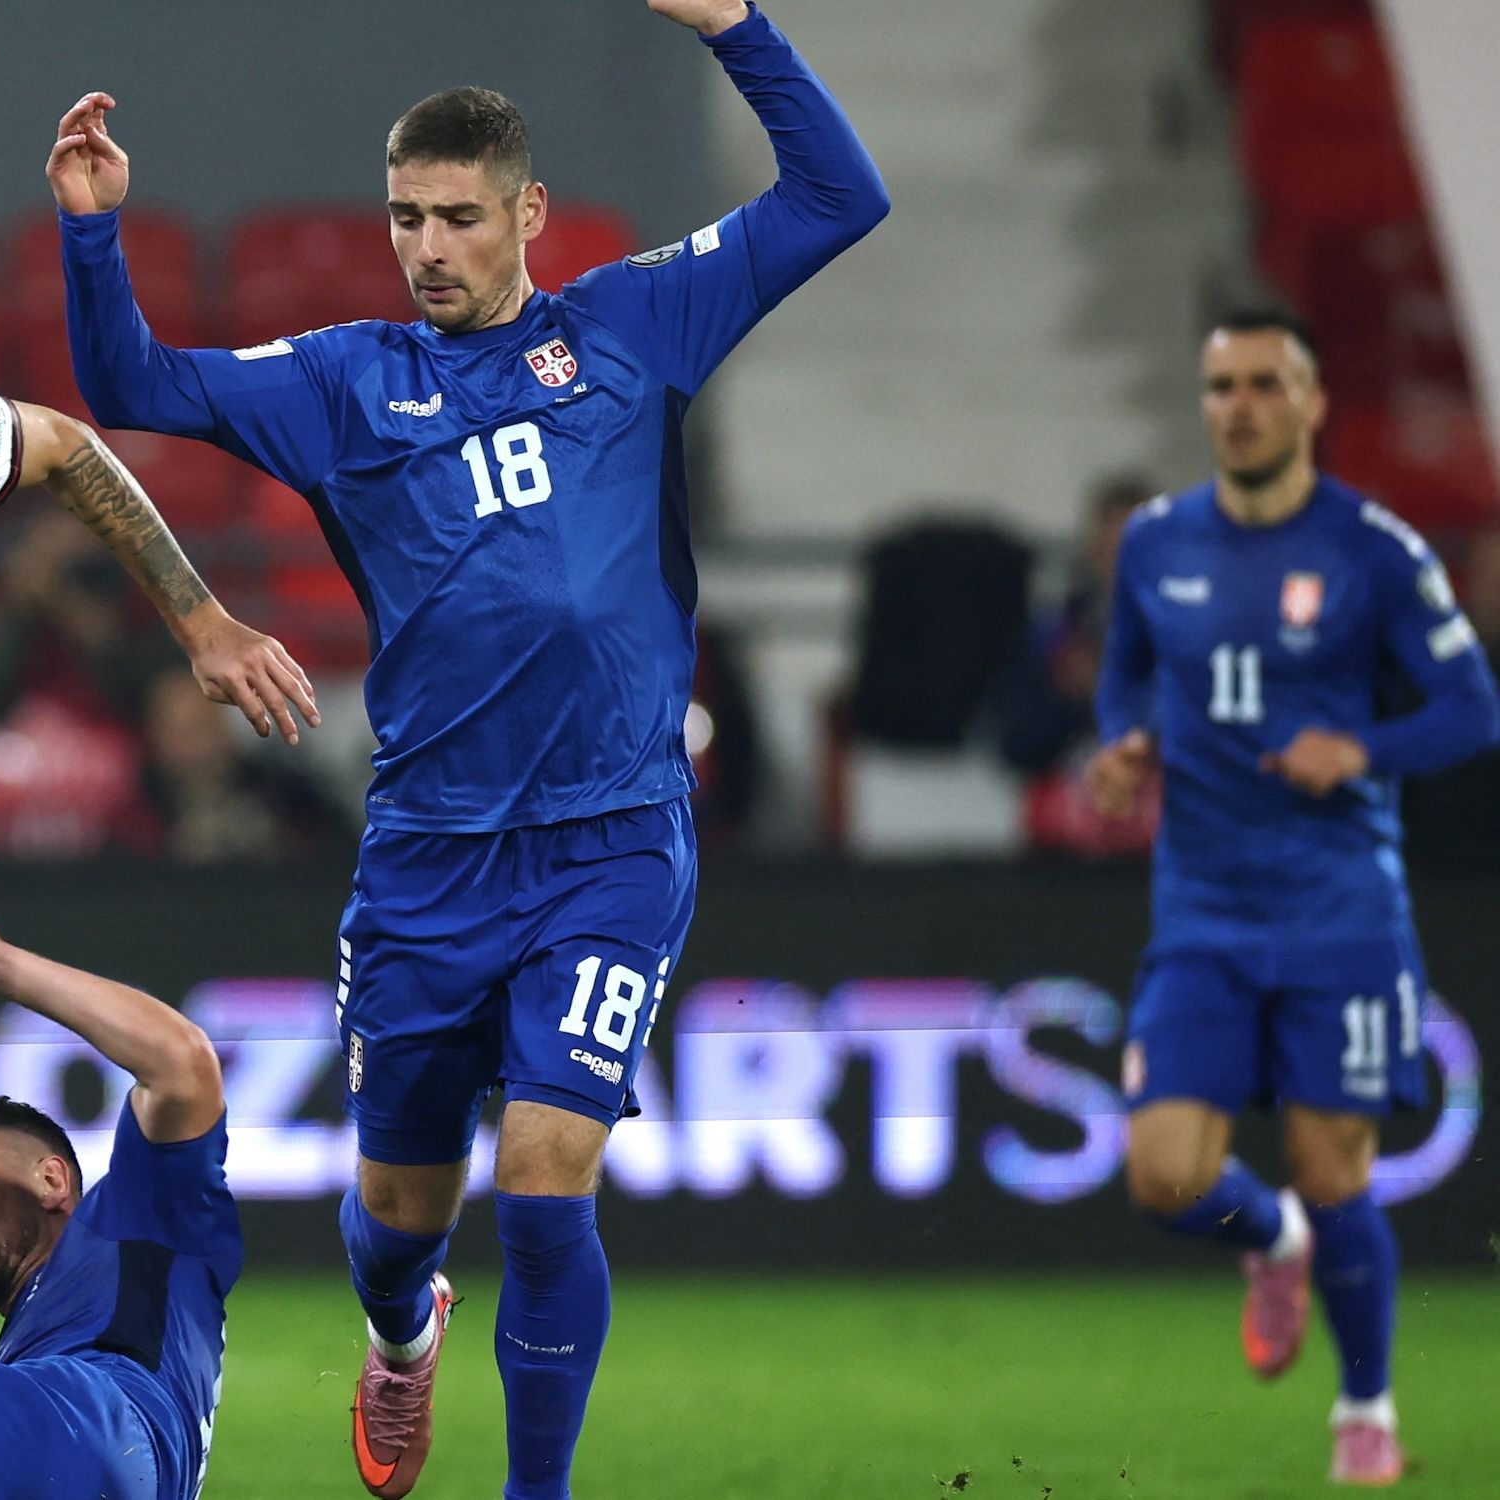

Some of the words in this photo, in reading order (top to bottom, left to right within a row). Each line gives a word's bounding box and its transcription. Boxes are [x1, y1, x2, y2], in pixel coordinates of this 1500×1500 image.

[388, 392, 443, 415] capelli
[460, 420, 553, 519] 18
[1207, 643, 1266, 724] 11
[558, 955, 647, 1054] 18
[1340, 993, 1388, 1069] 11
[569, 1048, 624, 1082] capelli
[593, 1068, 621, 1086] SPORT
